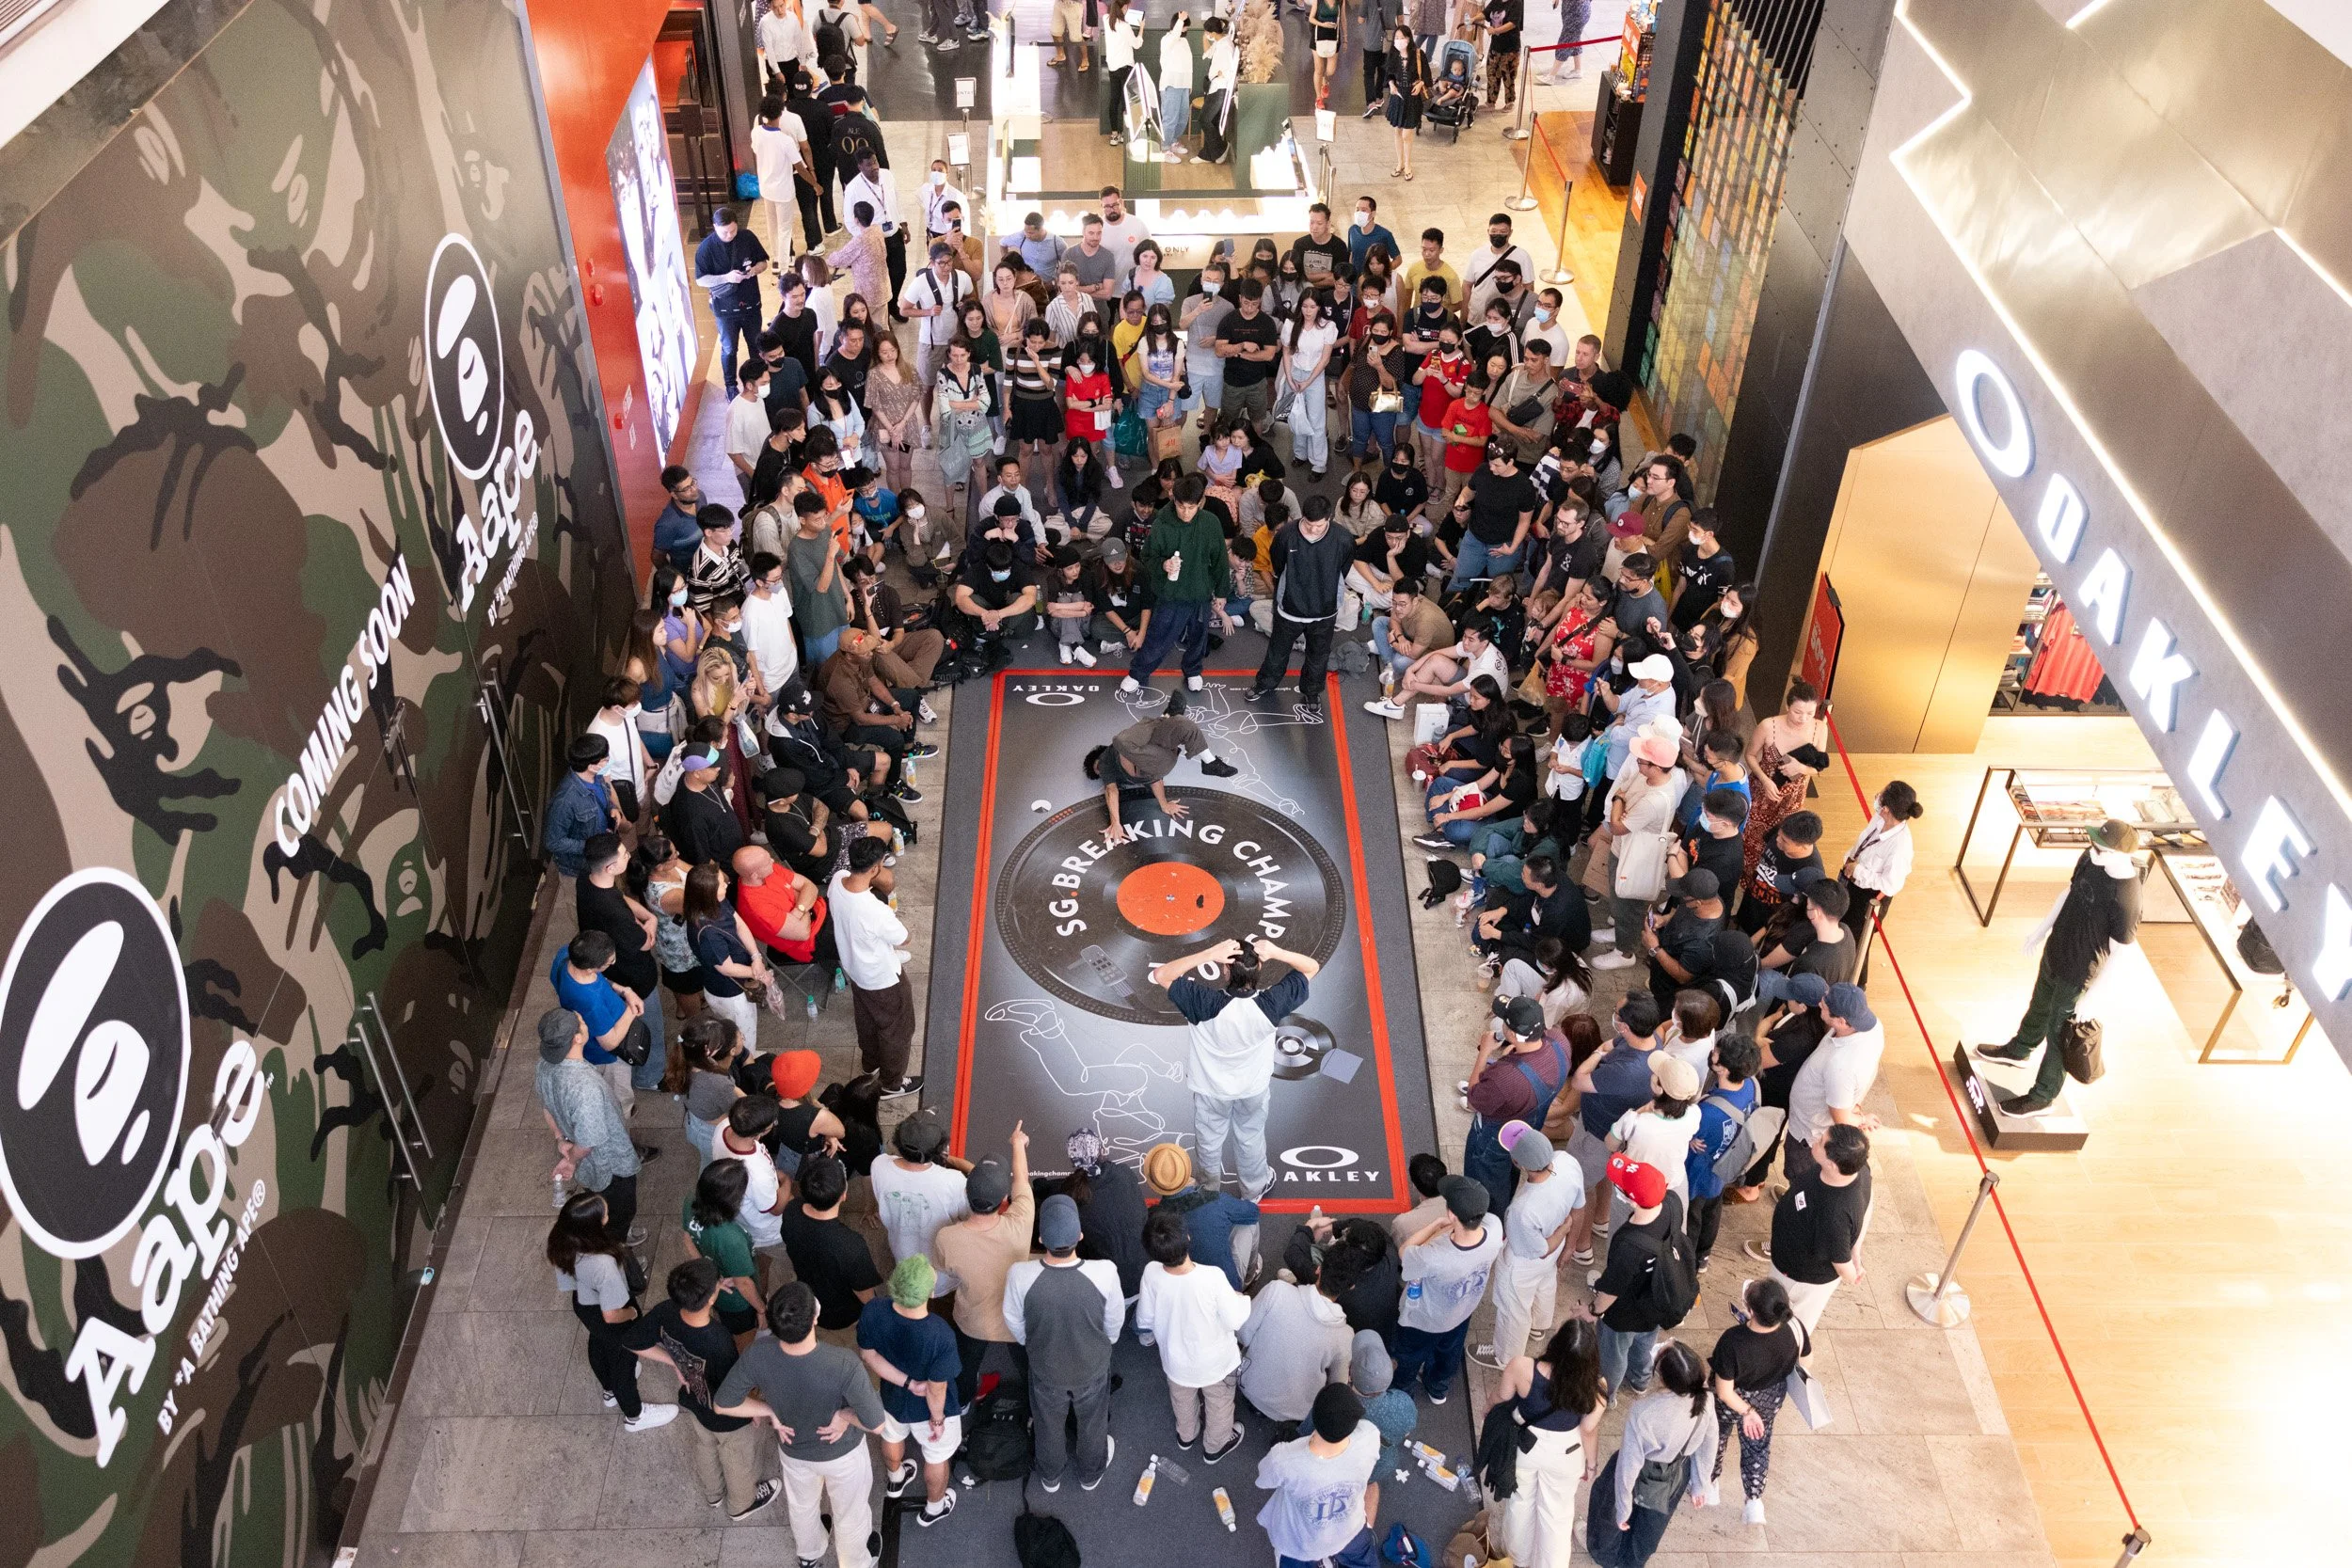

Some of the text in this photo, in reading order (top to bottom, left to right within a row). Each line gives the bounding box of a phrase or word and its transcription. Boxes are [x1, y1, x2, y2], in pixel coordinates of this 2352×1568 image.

[456, 409, 538, 612] Aape
[487, 600, 499, 627] BY
[503, 544, 526, 596] BATHING
[275, 553, 416, 858] COMING SOON
[1012, 685, 1100, 693] OAKLEY
[65, 1040, 265, 1467] Aape
[1283, 1171, 1380, 1182] AKLEY
[157, 1389, 180, 1435] BY
[190, 1251, 240, 1359] BATHING
